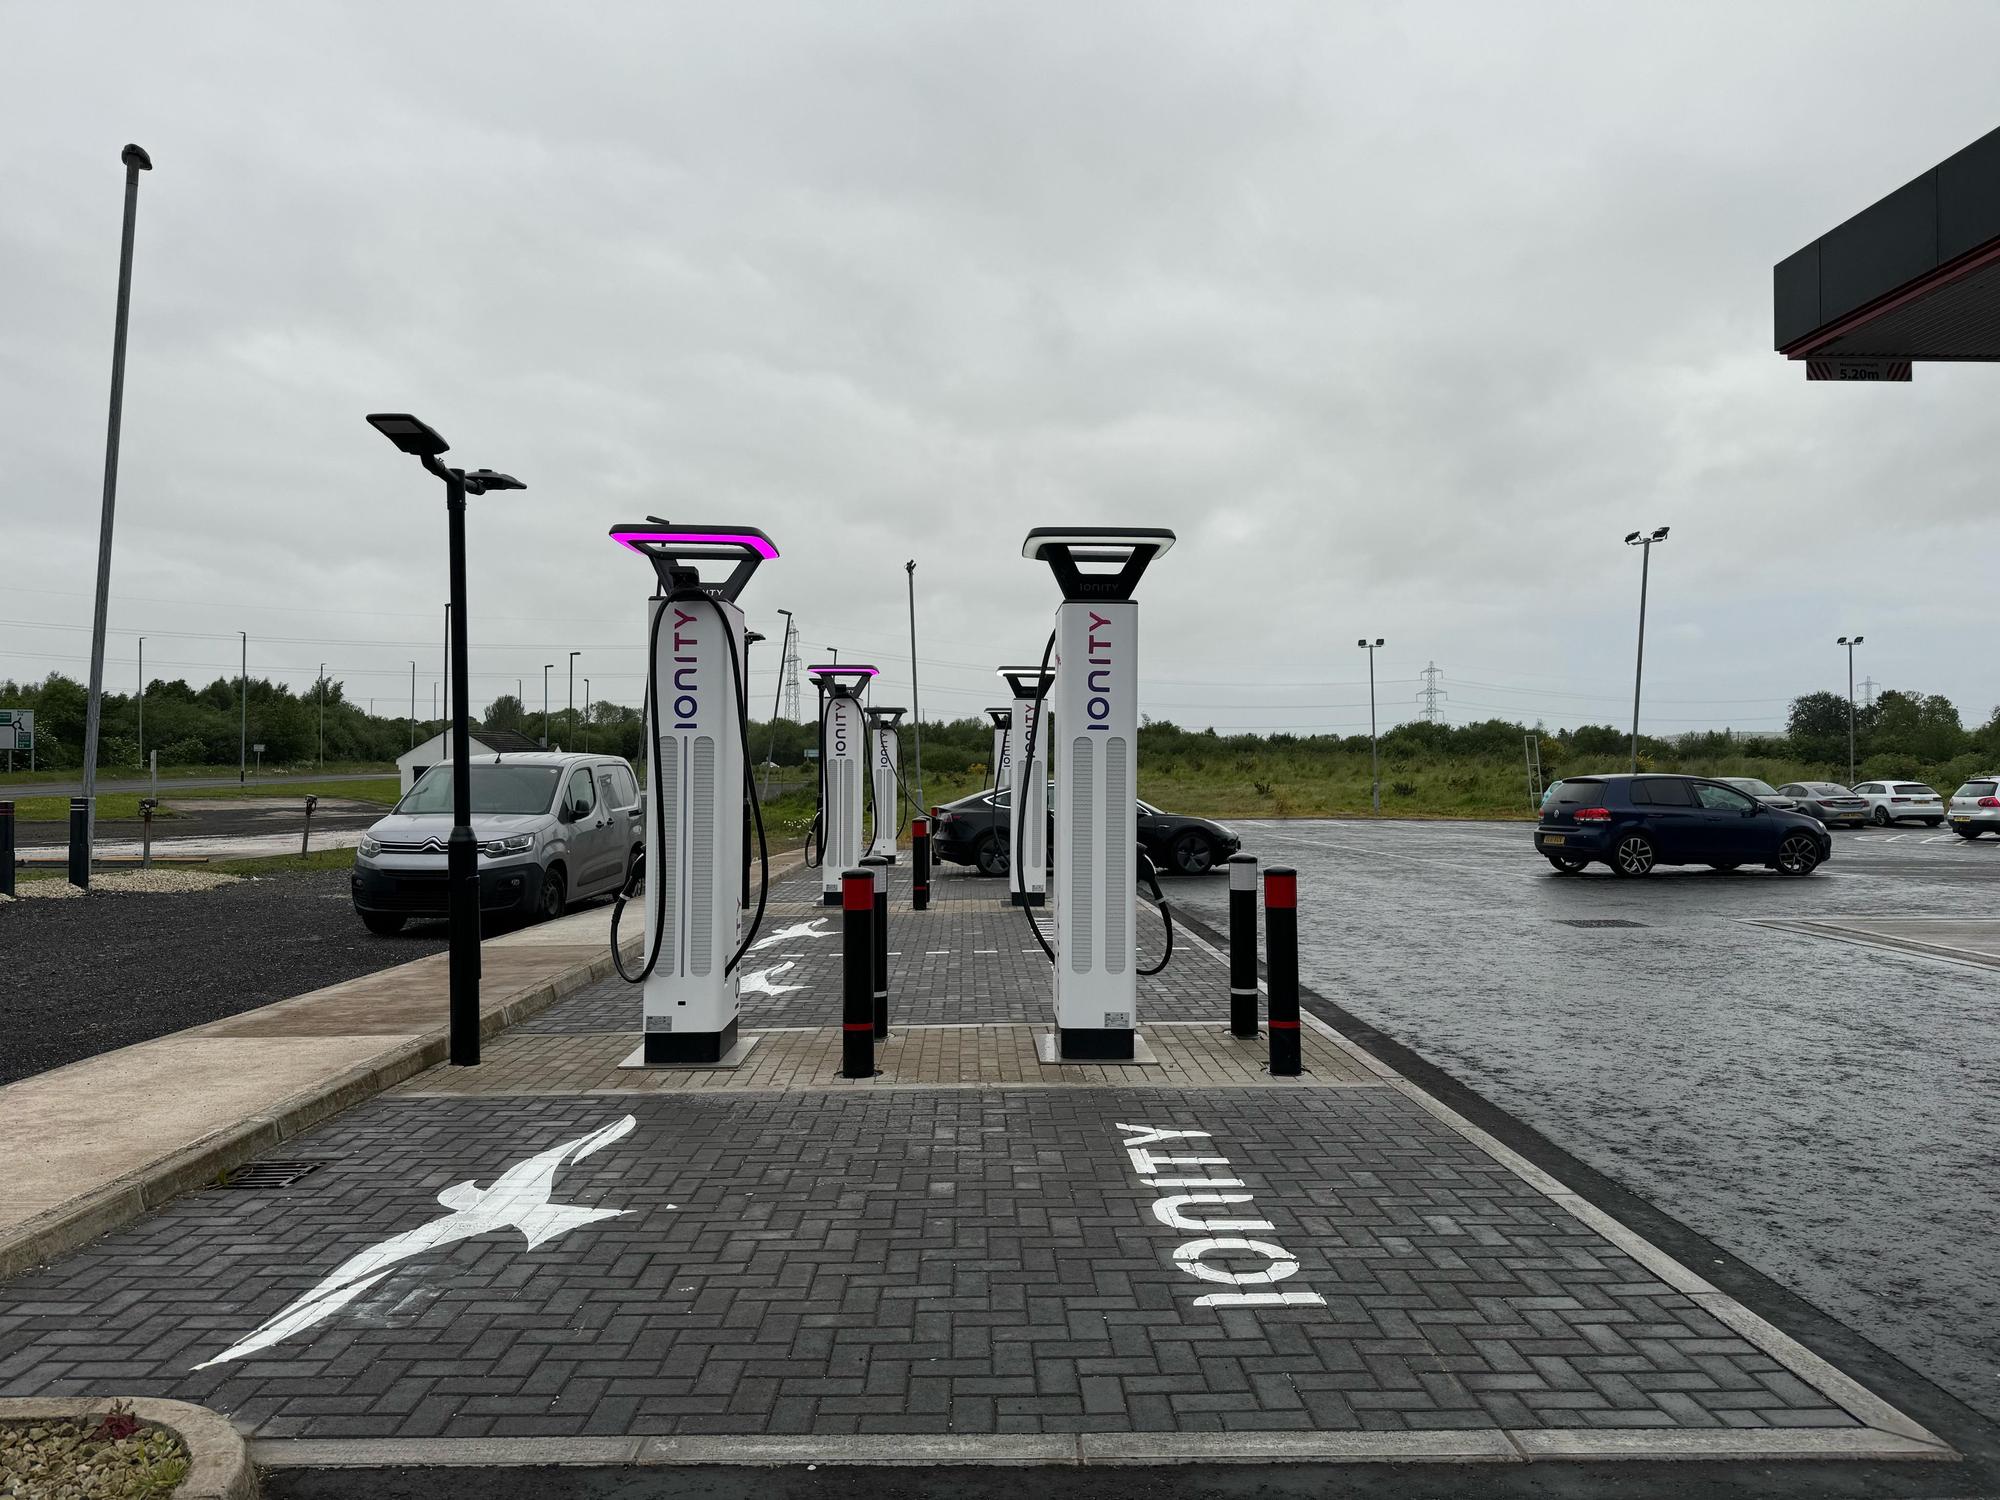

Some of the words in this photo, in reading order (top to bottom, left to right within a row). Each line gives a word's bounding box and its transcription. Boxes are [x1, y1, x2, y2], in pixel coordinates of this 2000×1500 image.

[1840, 369, 1879, 379] 5.20m
[674, 608, 698, 729] IONITY
[1087, 611, 1112, 730] IONITY
[836, 702, 846, 757] IONITY
[1115, 1122, 1328, 1306] IONITY
